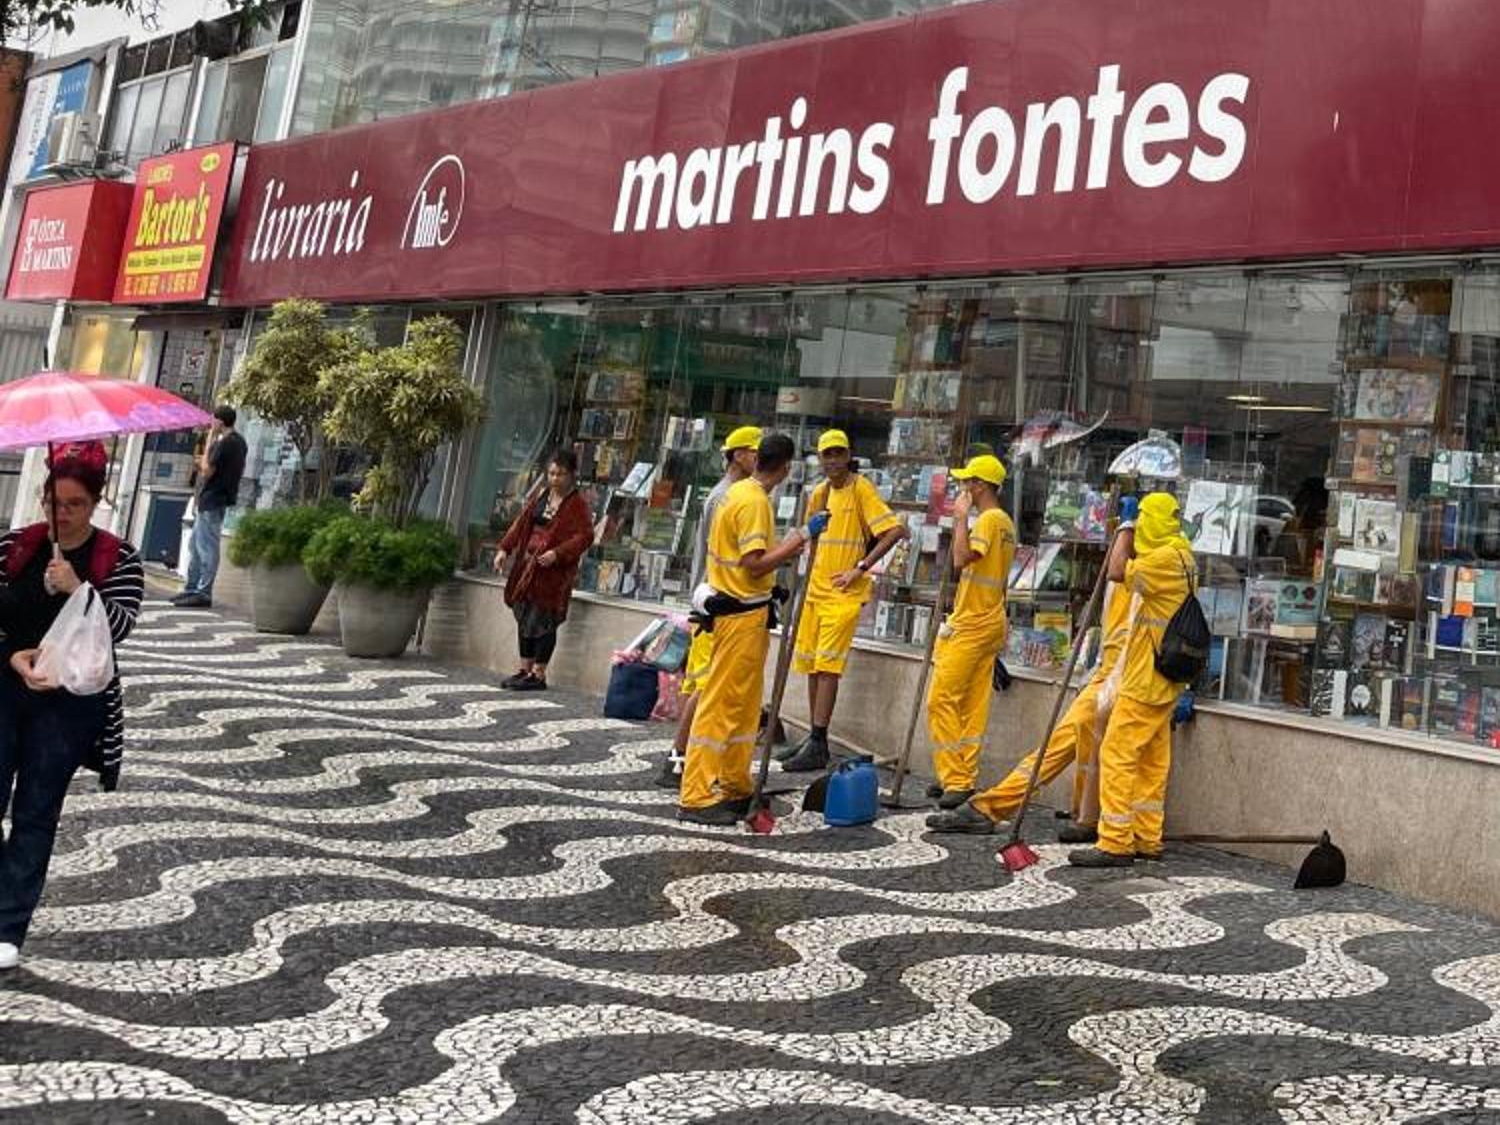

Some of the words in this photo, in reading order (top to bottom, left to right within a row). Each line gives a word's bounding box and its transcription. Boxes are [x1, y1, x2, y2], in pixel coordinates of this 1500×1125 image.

[612, 96, 895, 233] martins
[925, 63, 1251, 205] fontes
[134, 179, 211, 247] Barton's
[251, 170, 373, 262] livraria
